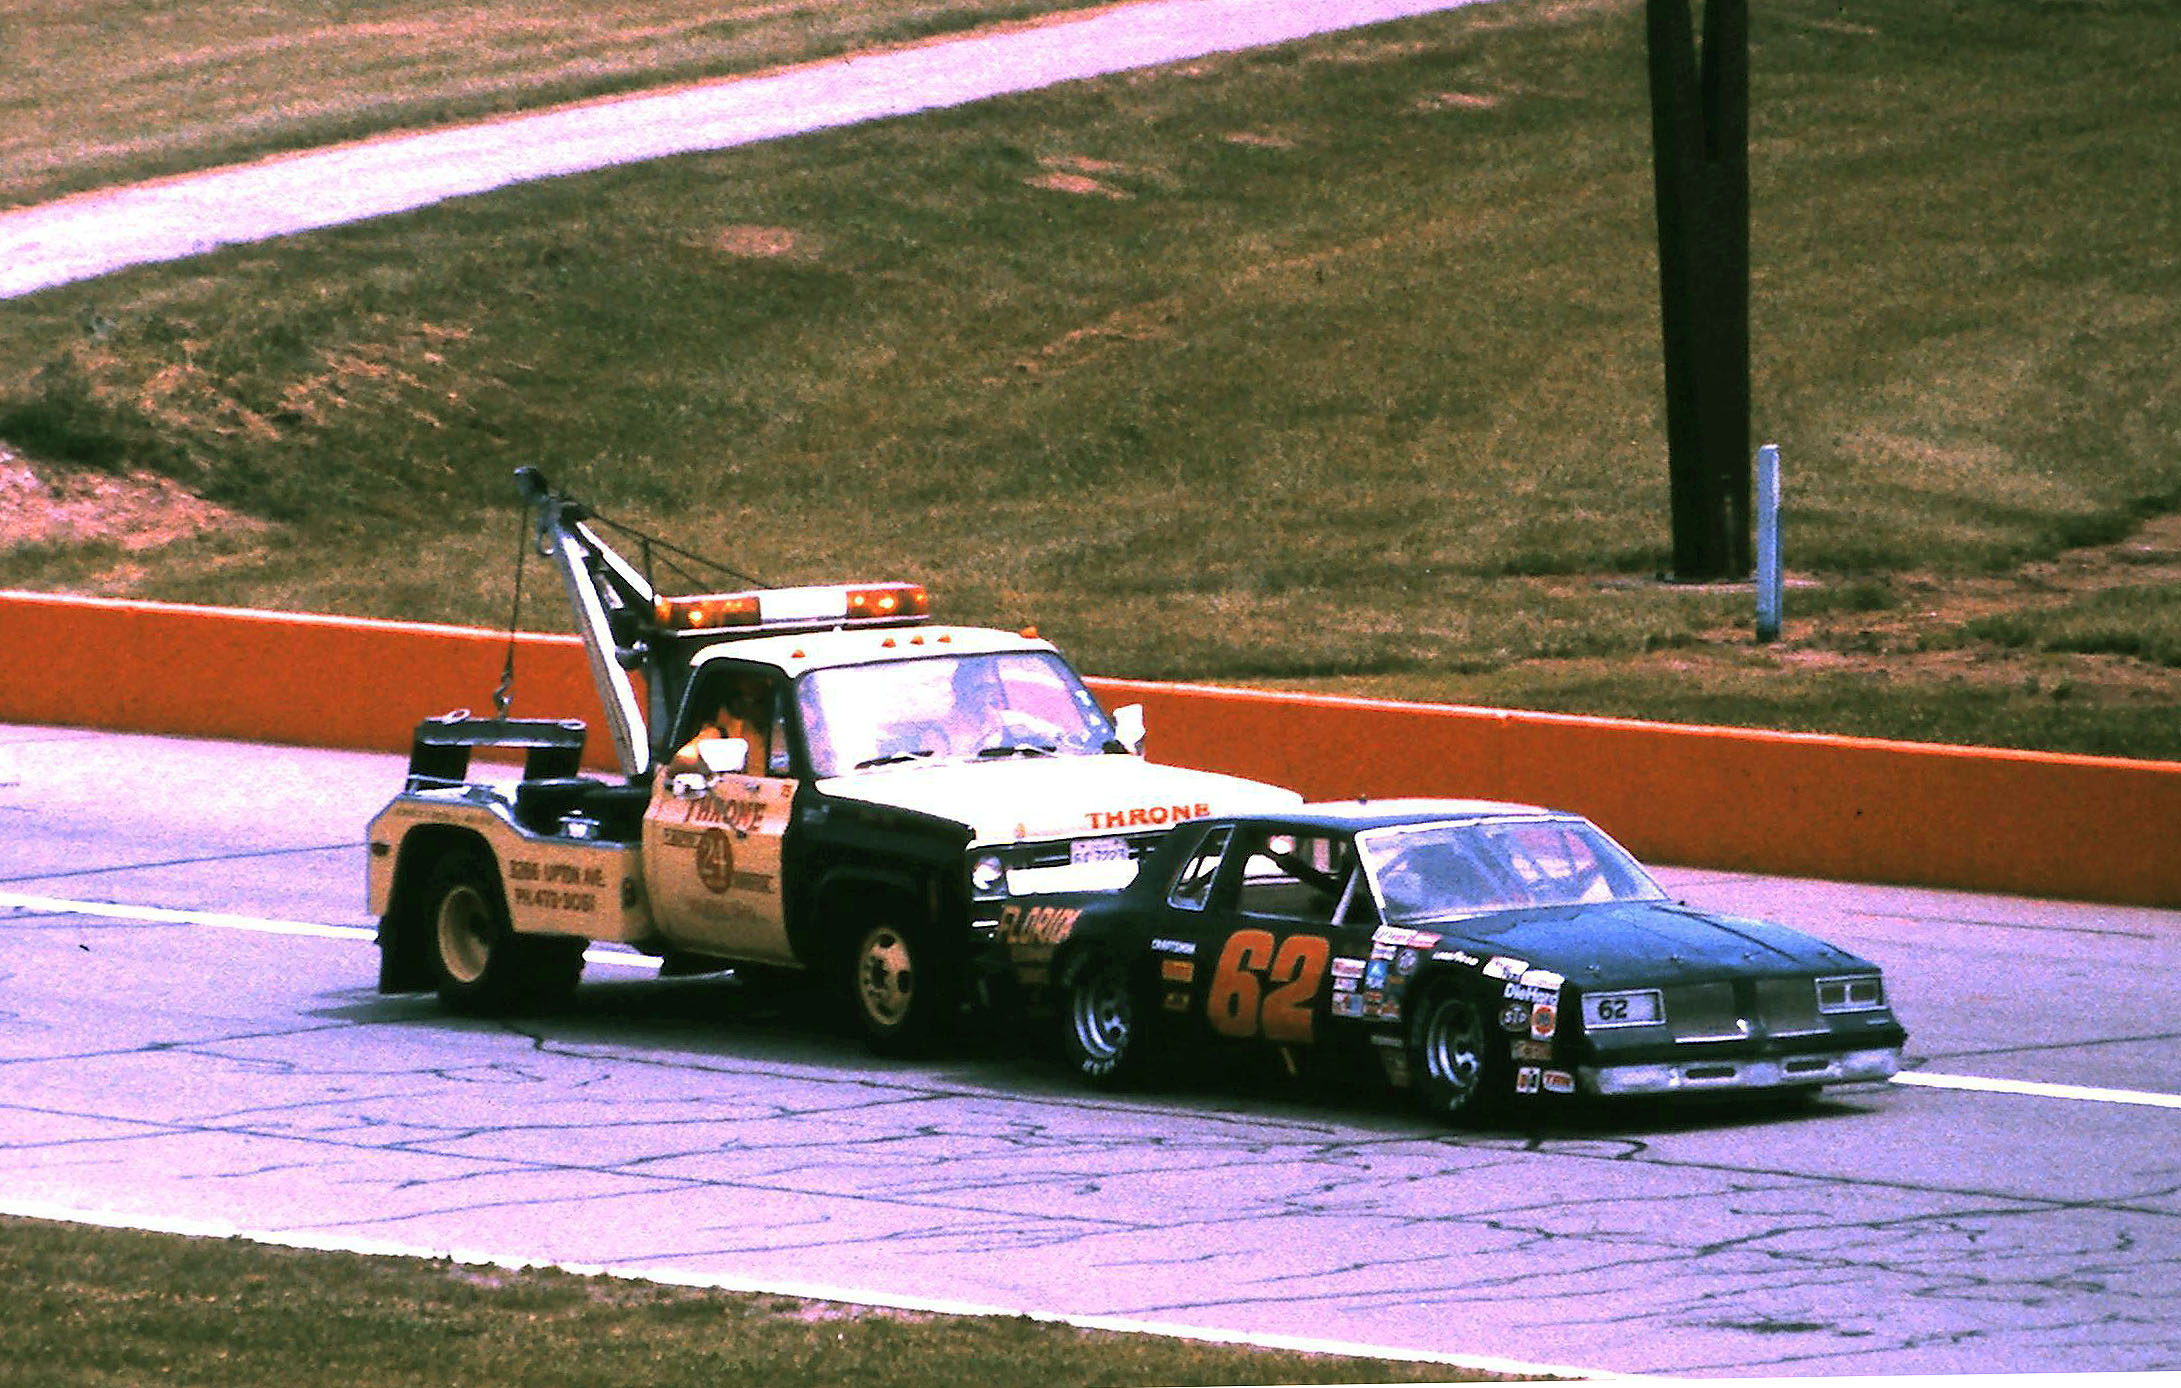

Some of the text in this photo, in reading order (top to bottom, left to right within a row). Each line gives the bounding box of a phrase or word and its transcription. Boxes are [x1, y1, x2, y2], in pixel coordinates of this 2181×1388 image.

[684, 799, 768, 832] THRONE
[1085, 803, 1211, 830] THRONE
[703, 836, 728, 880] 24
[1207, 929, 1331, 1042] 62
[1504, 1006, 1527, 1024] STP
[1598, 999, 1628, 1020] 62
